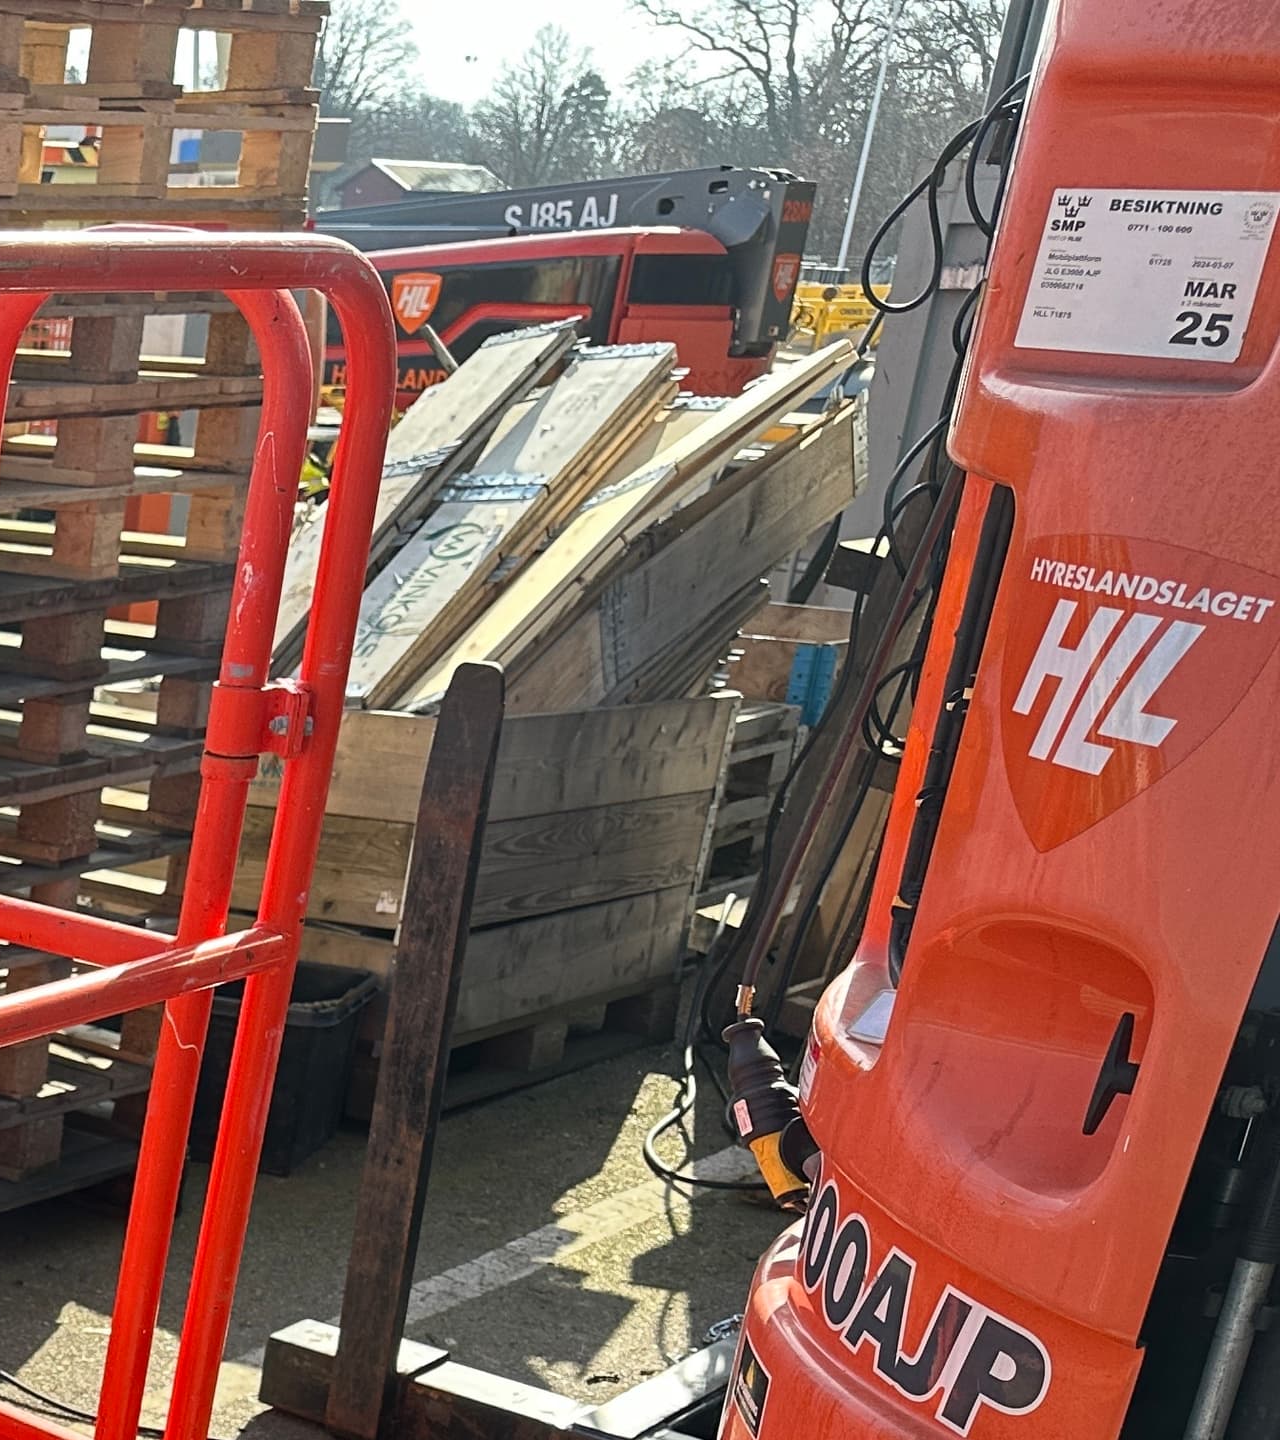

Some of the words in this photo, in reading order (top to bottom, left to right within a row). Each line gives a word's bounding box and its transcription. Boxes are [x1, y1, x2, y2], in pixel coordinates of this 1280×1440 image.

[580, 194, 619, 228] AJ
[1109, 199, 1223, 216] BESIKTNING
[1050, 219, 1086, 232] SMP
[1184, 281, 1237, 299] MAR
[1168, 311, 1234, 348] 25
[1030, 556, 1274, 624] HYRESLANDSLAGET
